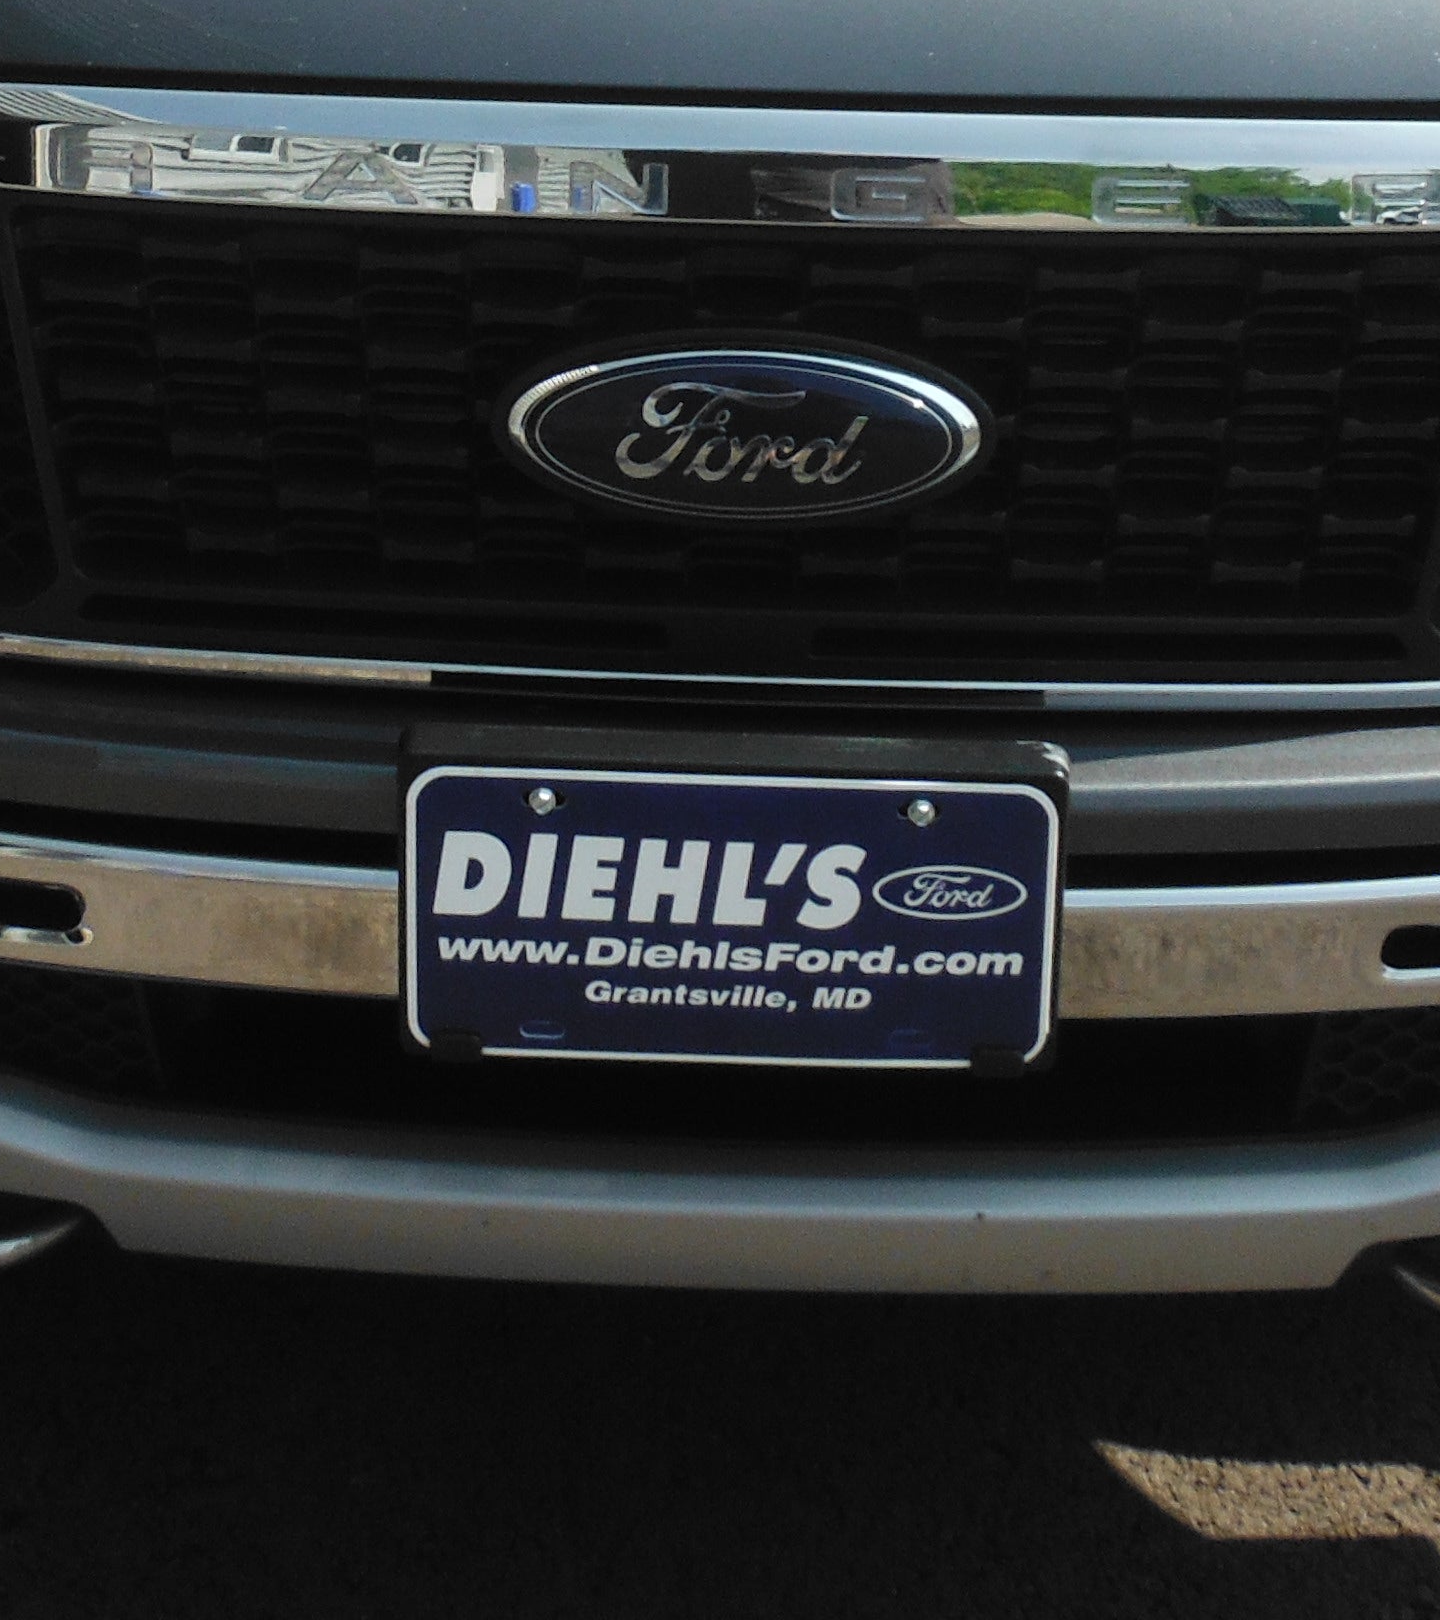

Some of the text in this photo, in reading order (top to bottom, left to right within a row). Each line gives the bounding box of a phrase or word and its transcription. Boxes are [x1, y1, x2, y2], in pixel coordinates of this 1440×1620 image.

[616, 381, 869, 486] Ford
[432, 830, 868, 930] DIEHL'S
[903, 873, 994, 908] Ford
[437, 936, 1024, 977] www.DiehlsFord.com
[584, 980, 873, 1013] Grantsville, MD
